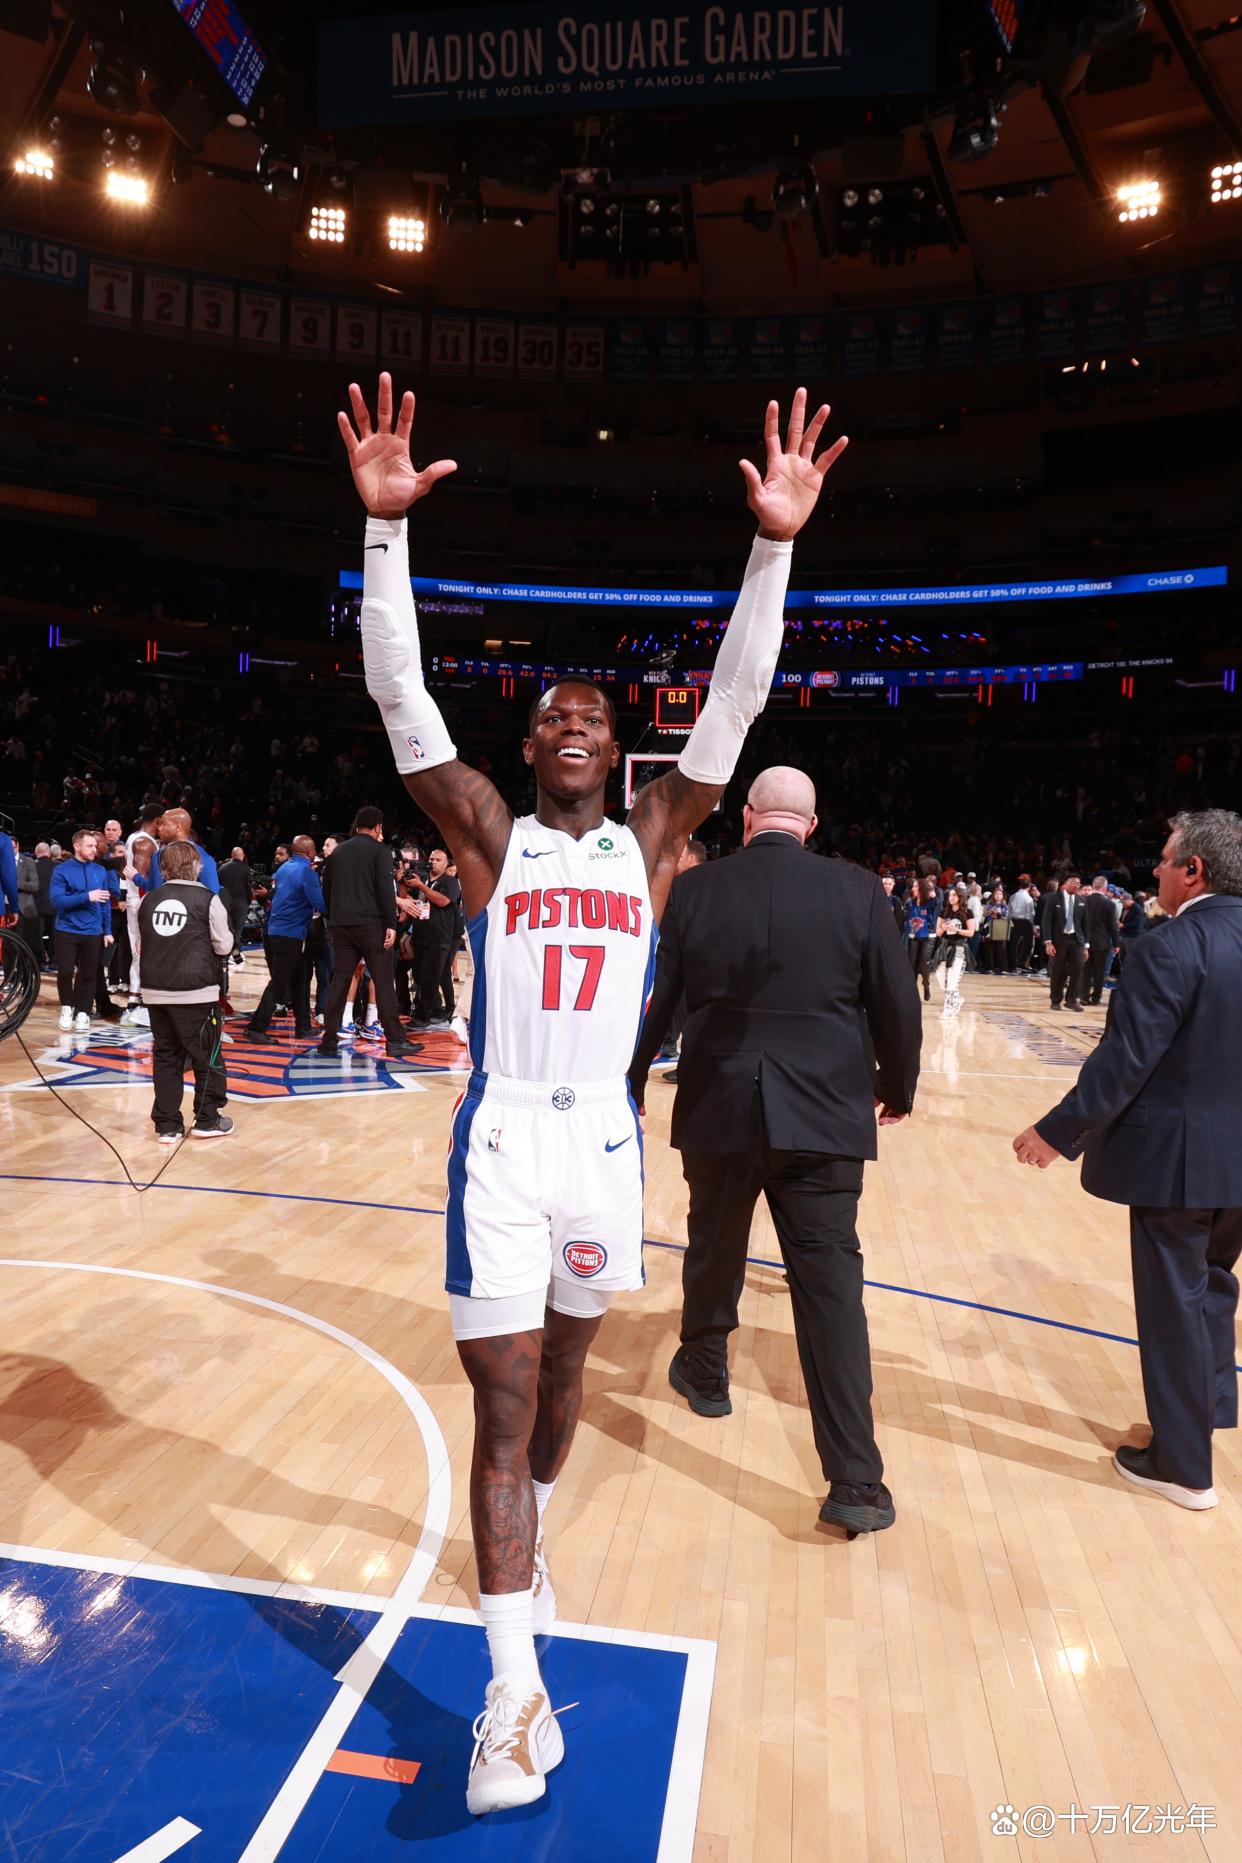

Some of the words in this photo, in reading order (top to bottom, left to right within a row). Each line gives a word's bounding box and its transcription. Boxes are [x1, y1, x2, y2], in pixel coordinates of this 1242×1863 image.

[391, 28, 543, 87] MADISON
[556, 16, 691, 76] SQUARE
[703, 5, 846, 64] GARDEN
[456, 88, 488, 100] THE
[495, 82, 573, 98] WORLD'S
[579, 79, 626, 93] MOST
[634, 74, 706, 88] FAMOUS
[28, 241, 78, 279] 150
[102, 282, 116, 311] 1
[156, 292, 174, 322] 2
[204, 301, 222, 329] 3
[252, 309, 269, 338] 7
[301, 316, 318, 344] 9
[348, 322, 365, 350] 9
[389, 328, 412, 357] 11
[437, 333, 462, 362] 11
[480, 336, 509, 364] 19
[522, 338, 553, 367] 30
[567, 340, 601, 369] 35
[438, 583, 474, 593] TONIGHT
[476, 585, 501, 595] ONLY:
[502, 588, 528, 596] CHASE
[529, 589, 587, 600] CARDHOLDERS
[588, 592, 603, 600] GET
[605, 593, 621, 601] 50%
[623, 593, 637, 601] OFF
[639, 594, 662, 602] FOOD
[683, 595, 713, 604] DRINKS
[814, 594, 851, 603] TONIGHT
[853, 594, 879, 602] ONLY:
[880, 592, 907, 601] CHASE
[909, 589, 971, 600] CARDHOLDERS
[972, 589, 989, 598] GET
[990, 588, 1009, 597] 50%
[1010, 587, 1027, 596] OFF
[1028, 585, 1053, 595] FOOD
[1055, 584, 1076, 594] AND
[1078, 582, 1112, 592] DRINKS
[1147, 576, 1184, 587] CHASE
[643, 675, 670, 683] KNIC
[782, 674, 802, 682] 100
[852, 676, 885, 685] PISTONS
[668, 691, 687, 703] 0.0
[153, 910, 187, 927] TNT
[505, 887, 643, 937] PISTONS
[542, 944, 606, 1011] 17
[570, 1250, 599, 1261] DETROIT
[570, 1257, 599, 1267] PISTONS
